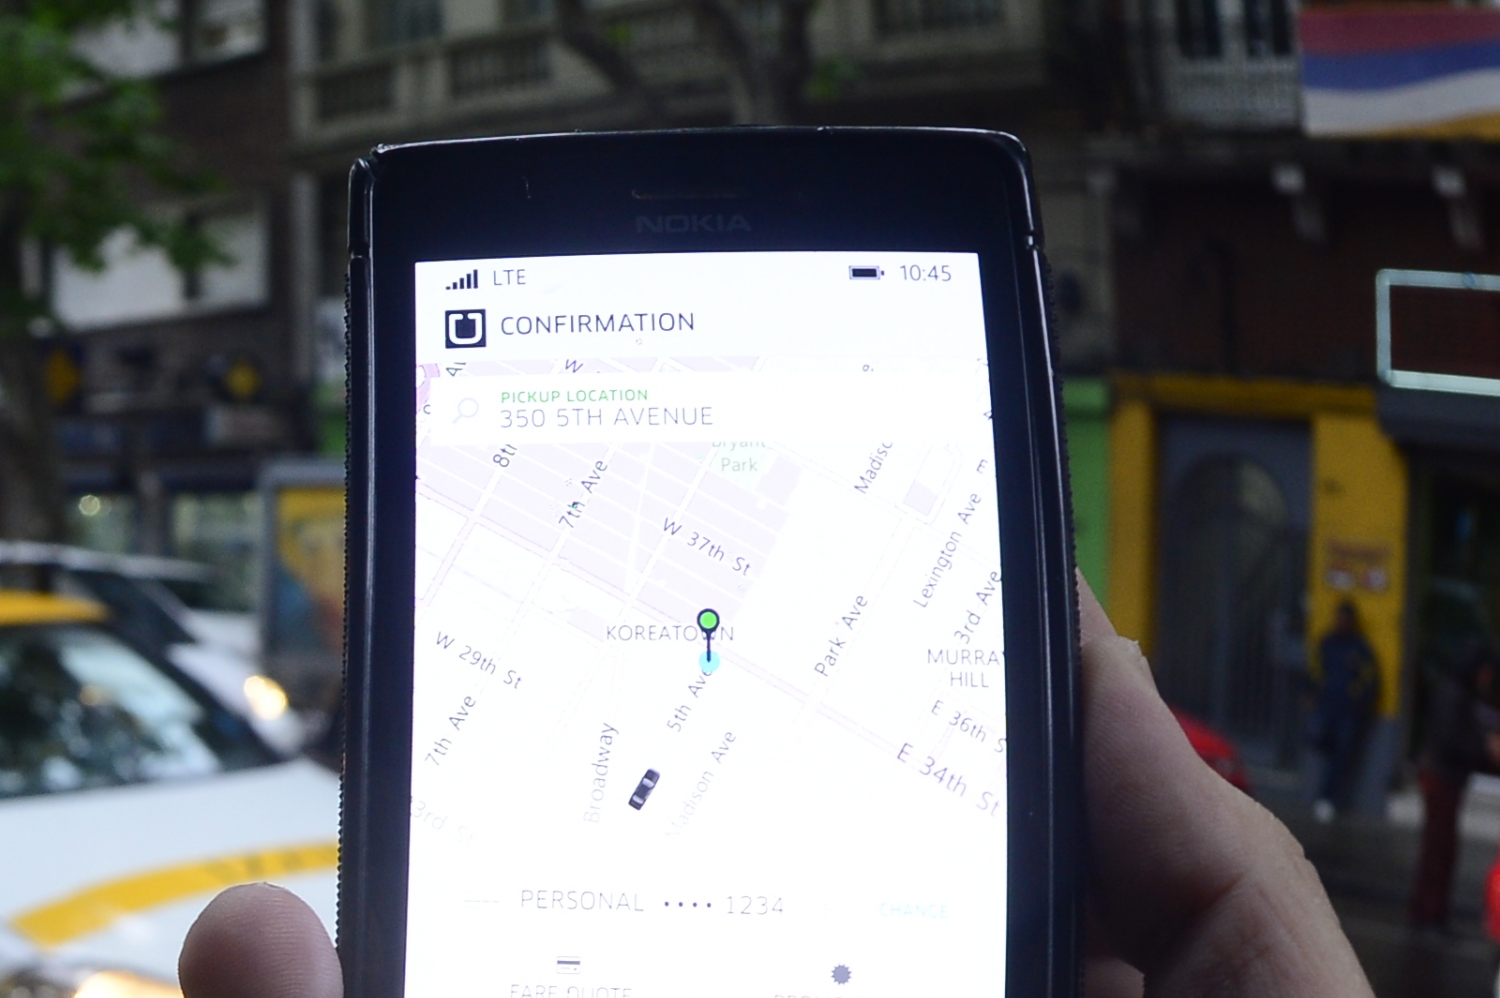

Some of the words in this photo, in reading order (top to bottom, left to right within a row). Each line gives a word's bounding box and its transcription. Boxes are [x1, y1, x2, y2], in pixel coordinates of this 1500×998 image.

[635, 213, 753, 234] NOKIA
[492, 268, 527, 287] LTE
[899, 264, 952, 282] 10:45
[500, 312, 695, 336] CONFIRMATION
[501, 390, 561, 404] PICKUP
[566, 389, 648, 402] LOCATION
[500, 408, 546, 428] 350
[556, 407, 602, 427] 5TH
[613, 406, 714, 426] AVENUE
[720, 456, 759, 472] Park
[557, 499, 586, 529] 7th
[580, 459, 608, 494] Ave
[663, 516, 684, 536] W
[686, 531, 725, 562] 37th
[731, 556, 752, 577] St
[912, 530, 963, 609] Lexington
[957, 492, 982, 525] Ave
[953, 609, 982, 645] 3rd
[975, 569, 1001, 606] Ave
[606, 624, 735, 642] KOREATON
[813, 636, 847, 677] Park
[841, 594, 868, 630] Ave
[435, 631, 456, 649] W
[458, 645, 497, 675] 29th
[502, 669, 523, 690] St
[927, 648, 1003, 666] MURRA
[949, 671, 990, 688] HILL
[424, 737, 452, 766] 7th
[448, 695, 476, 731] Ave
[666, 703, 692, 733] 5th
[931, 699, 945, 717] E
[948, 710, 987, 742] 36th
[994, 737, 1006, 754] S
[583, 722, 620, 824] Broadway
[664, 769, 715, 840] Madison
[710, 731, 736, 764] Ave
[896, 742, 914, 764] E
[918, 755, 967, 797] 34th
[976, 790, 1001, 818] St
[520, 889, 645, 912] PERSONAL
[726, 895, 784, 915] 1234
[879, 901, 950, 919] CHANGE
